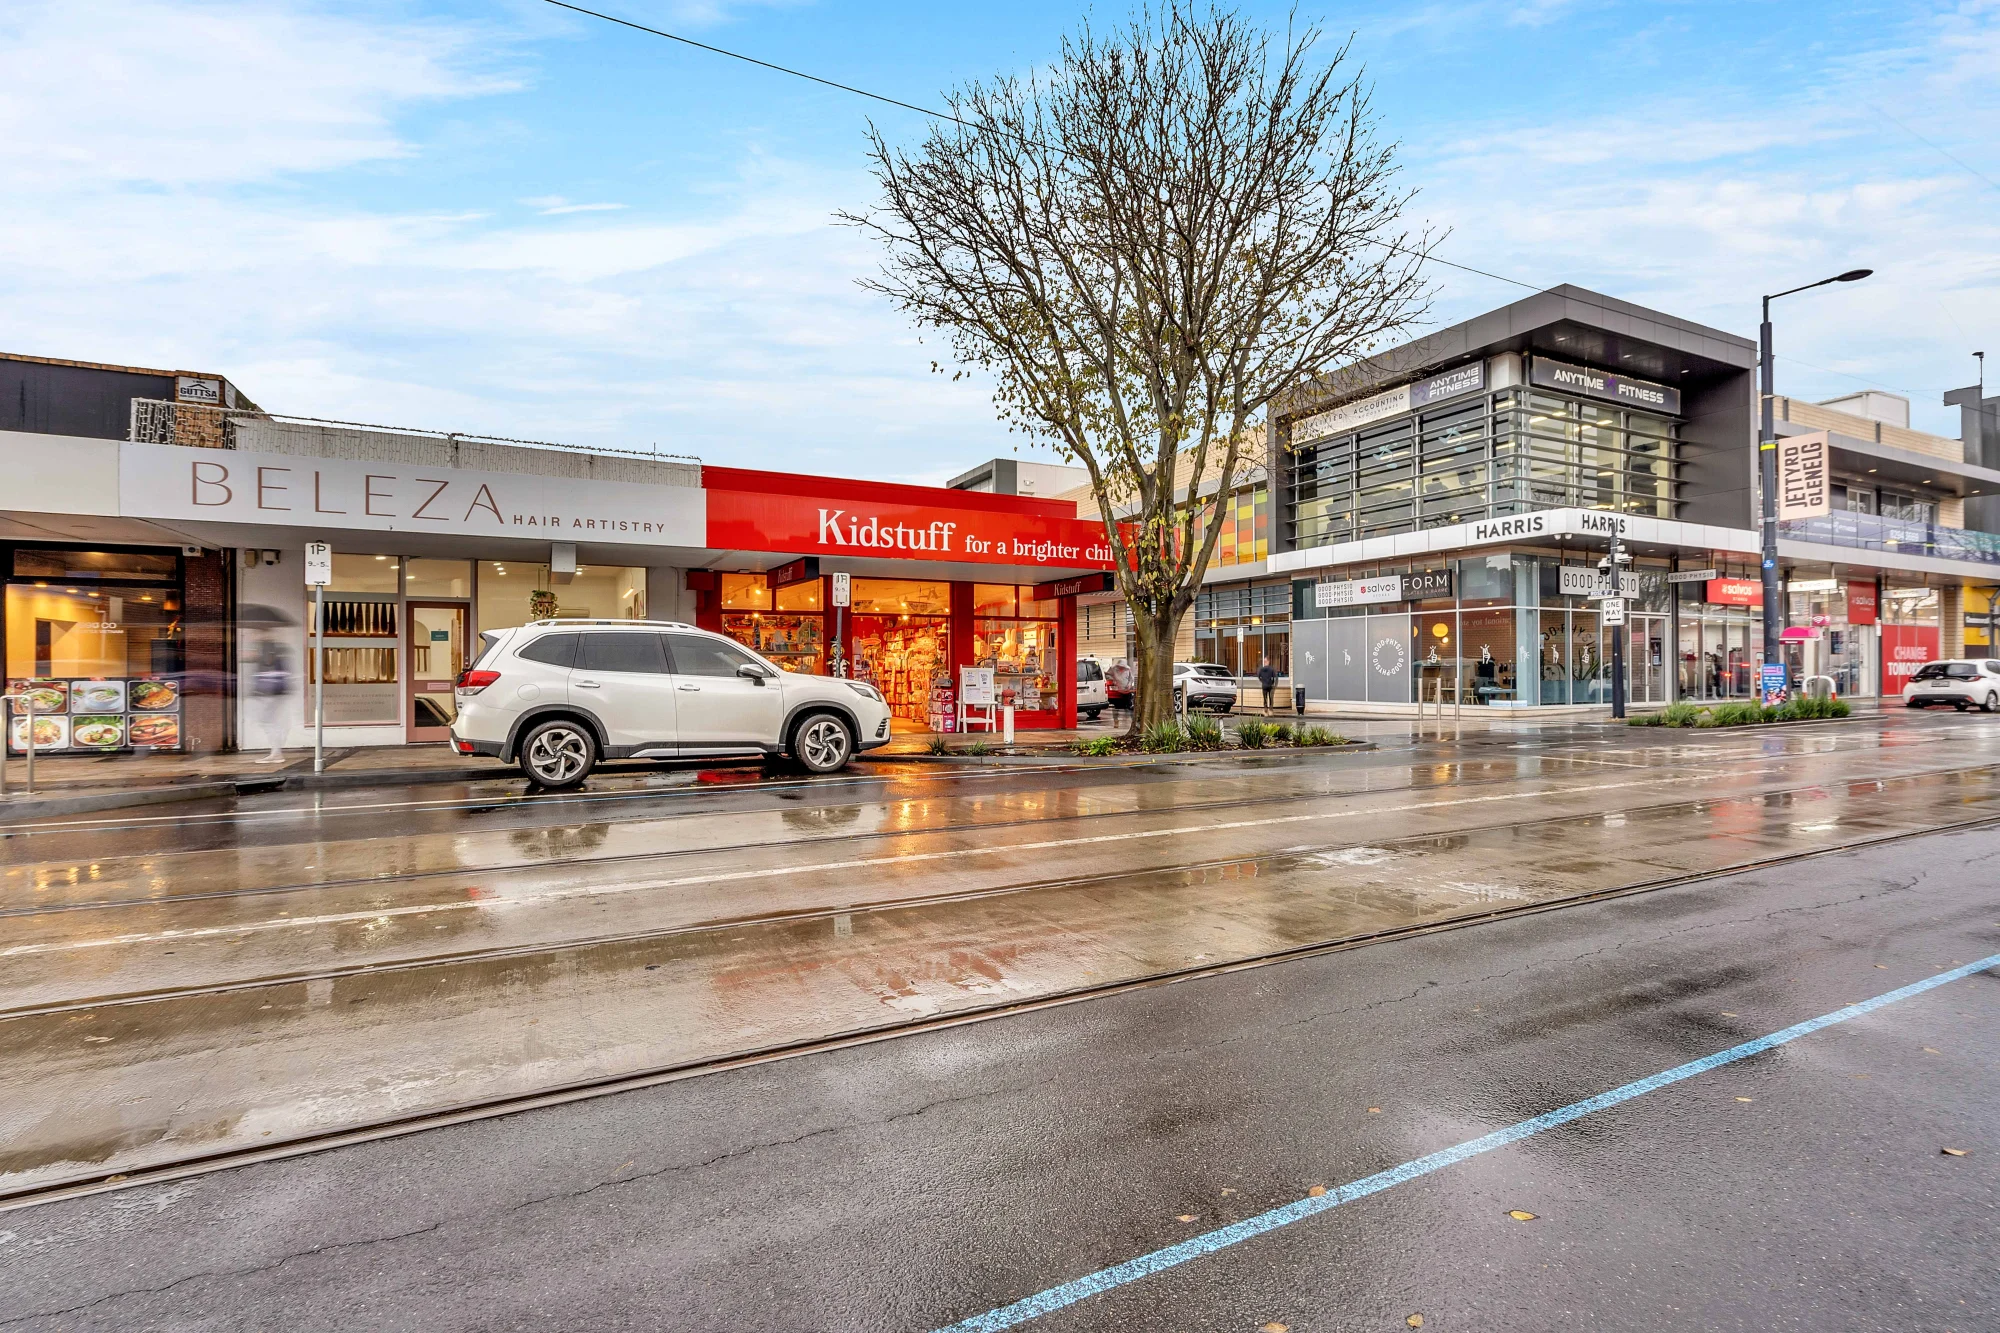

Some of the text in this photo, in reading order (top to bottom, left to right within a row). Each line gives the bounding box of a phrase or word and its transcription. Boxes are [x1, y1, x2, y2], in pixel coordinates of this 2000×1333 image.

[1429, 367, 1479, 389] ANYTIME
[1429, 376, 1480, 398] FITNESS
[1554, 369, 1664, 404] ANYTIME FITNESS
[180, 387, 217, 398] GUTTSA
[1353, 393, 1404, 415] ACCOUNTING
[1801, 442, 1823, 506] GLENELG
[192, 461, 665, 533] BELEZA HAIR ARTISTRY
[1476, 516, 1543, 540] HARRIS
[1582, 514, 1626, 533] HARRIS
[817, 508, 1115, 562] Kidstuff for a brighter chil
[310, 544, 326, 555] 1P
[1053, 581, 1082, 597] Kidstuff
[1367, 583, 1396, 592] salvos
[1402, 574, 1448, 591] FORM
[1563, 573, 1636, 592] GOOD·PHSIO
[1727, 583, 1753, 596] salvos
[1893, 646, 1928, 660] CHANGE
